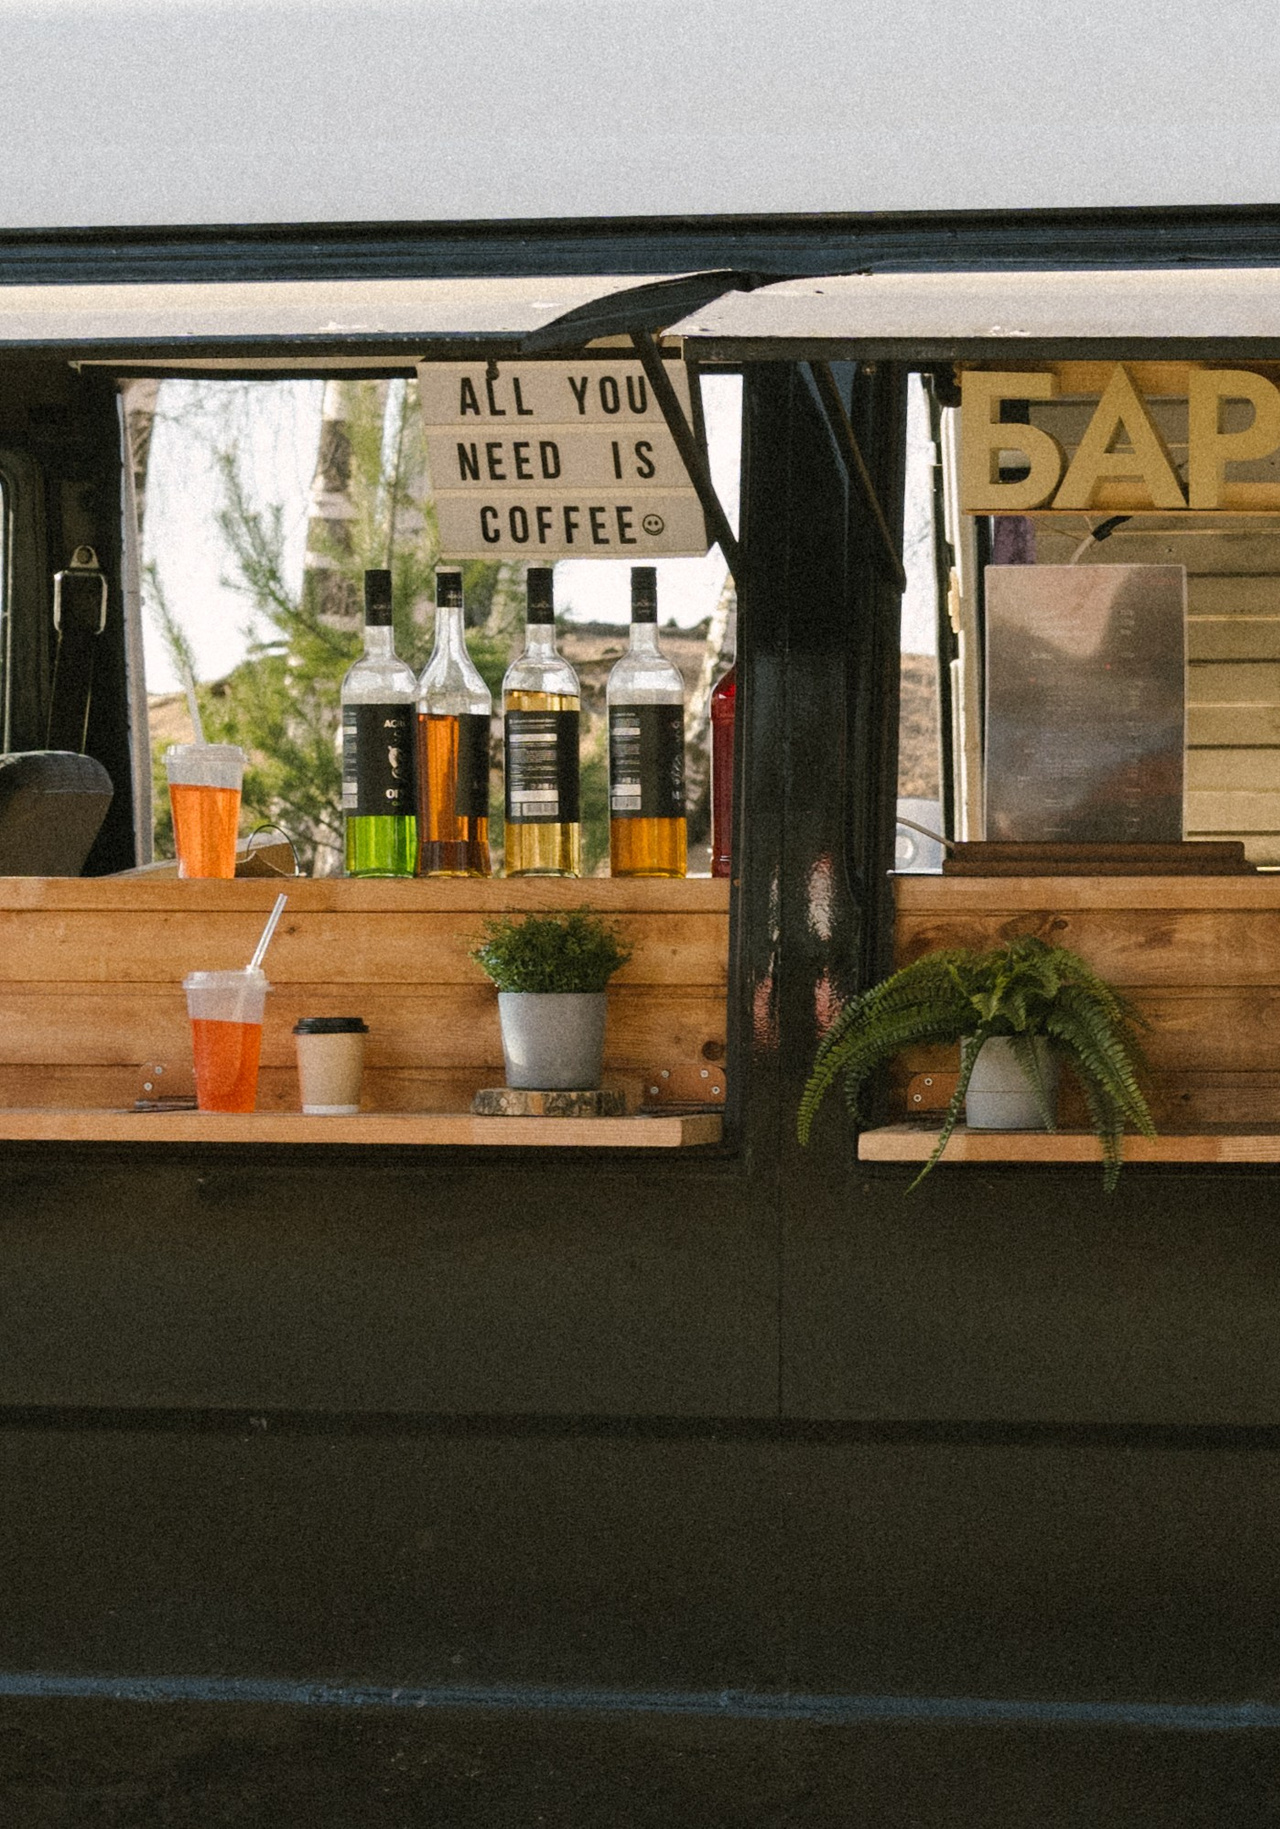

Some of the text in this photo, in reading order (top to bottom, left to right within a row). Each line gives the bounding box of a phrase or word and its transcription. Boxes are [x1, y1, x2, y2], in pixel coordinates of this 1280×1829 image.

[460, 375, 648, 416] ALL YOU
[457, 441, 656, 481] NEED IS
[480, 505, 637, 545] COFFEE
